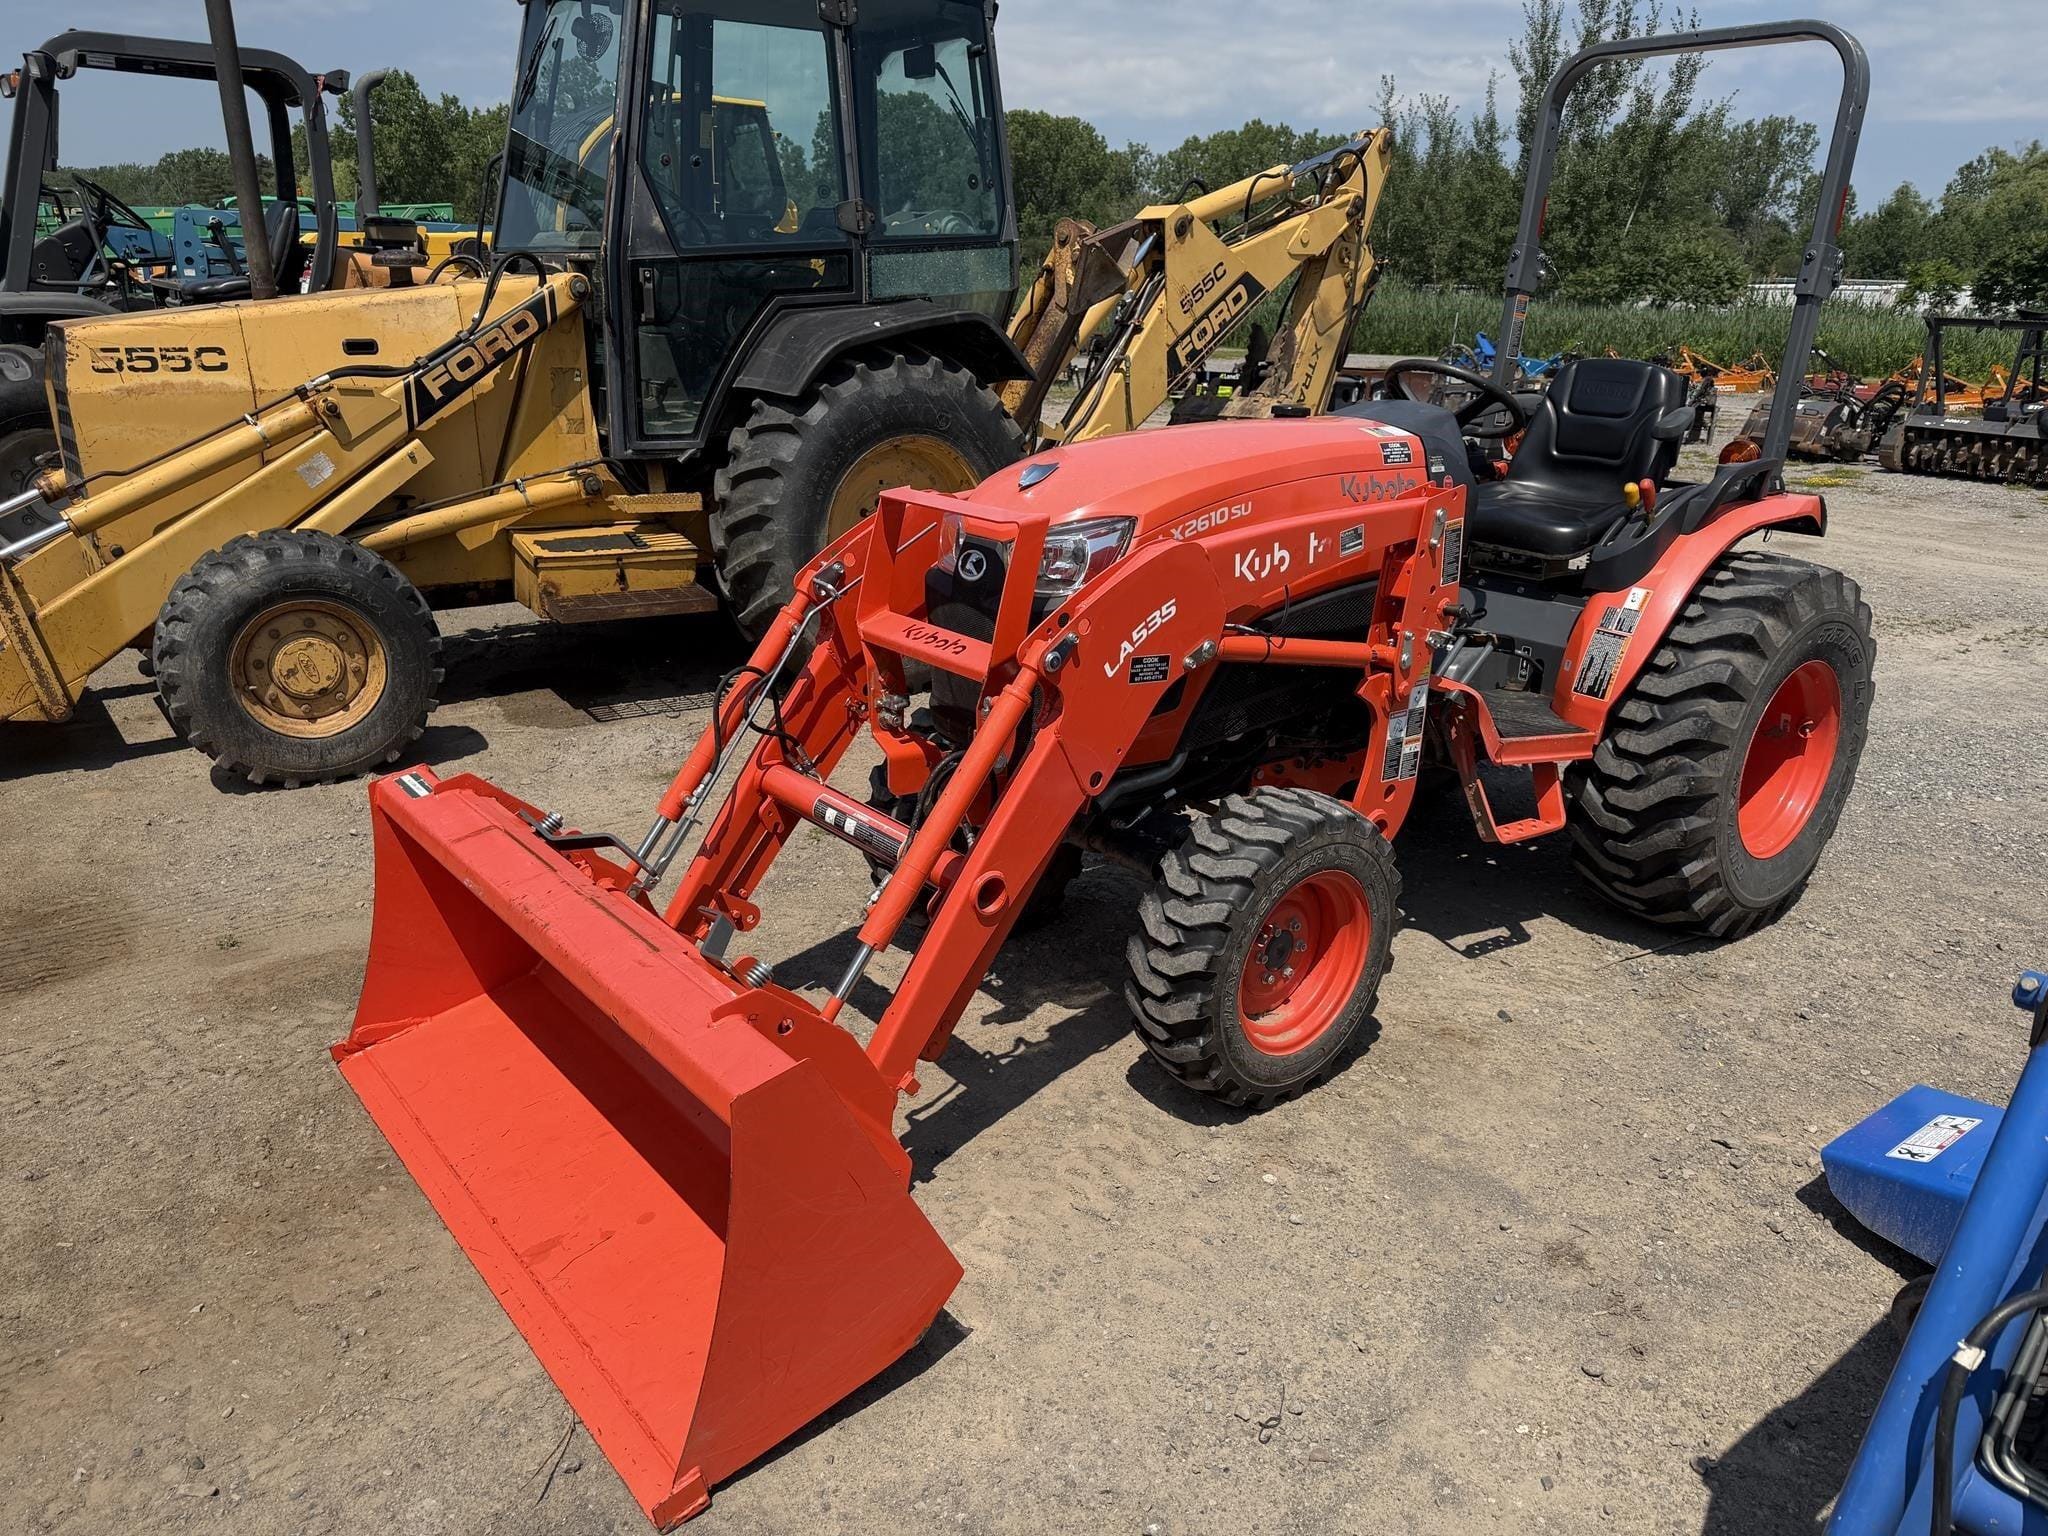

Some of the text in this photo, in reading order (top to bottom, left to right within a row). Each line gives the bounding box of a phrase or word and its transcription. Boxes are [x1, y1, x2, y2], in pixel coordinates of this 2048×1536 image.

[1180, 262, 1226, 314] 555C
[421, 310, 539, 400] FORD
[1175, 284, 1248, 367] FORD
[90, 346, 229, 373] 555C
[1296, 341, 1322, 402] XTRA
[902, 624, 967, 655] Kubota
[1104, 598, 1176, 678] LA535
